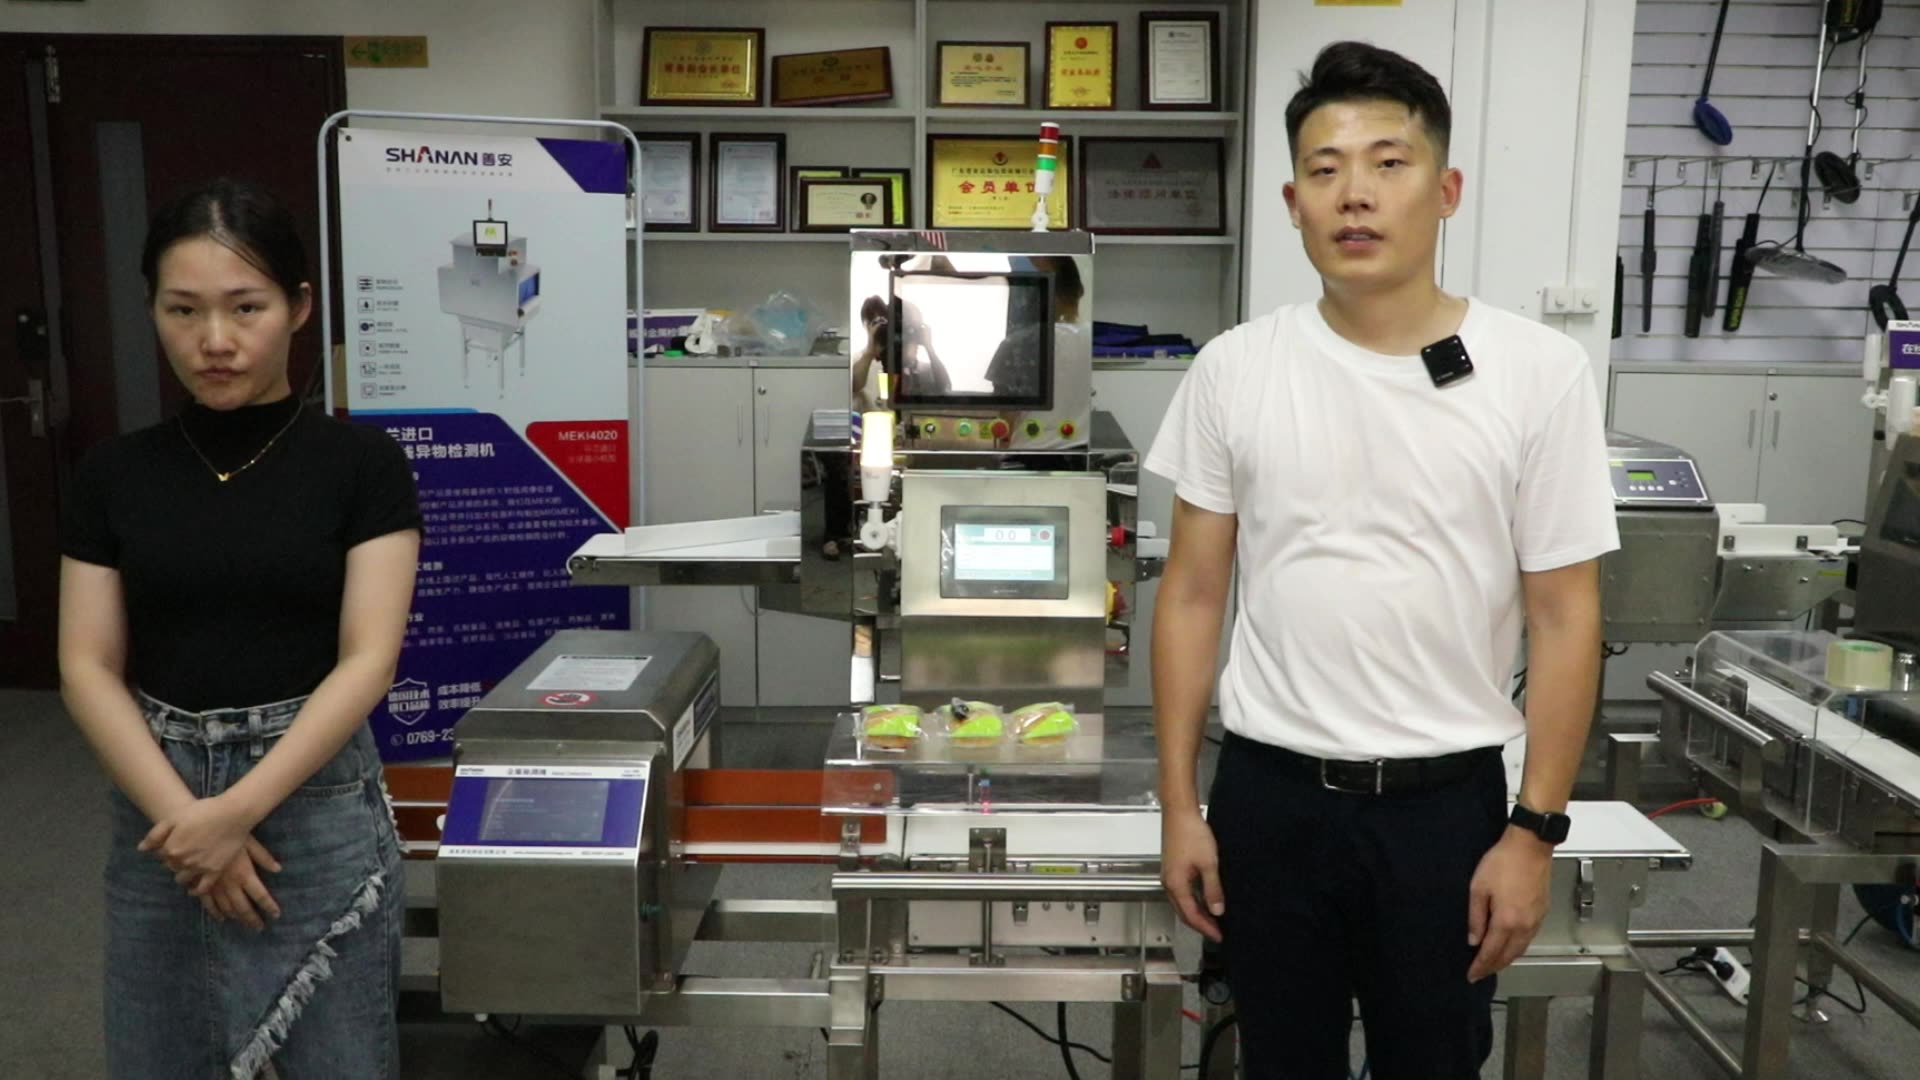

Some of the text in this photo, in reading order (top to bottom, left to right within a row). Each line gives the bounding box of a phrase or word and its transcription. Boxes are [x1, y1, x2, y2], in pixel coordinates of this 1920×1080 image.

[385, 146, 513, 167] SHANAN 善安
[558, 430, 618, 441] MEKI4020
